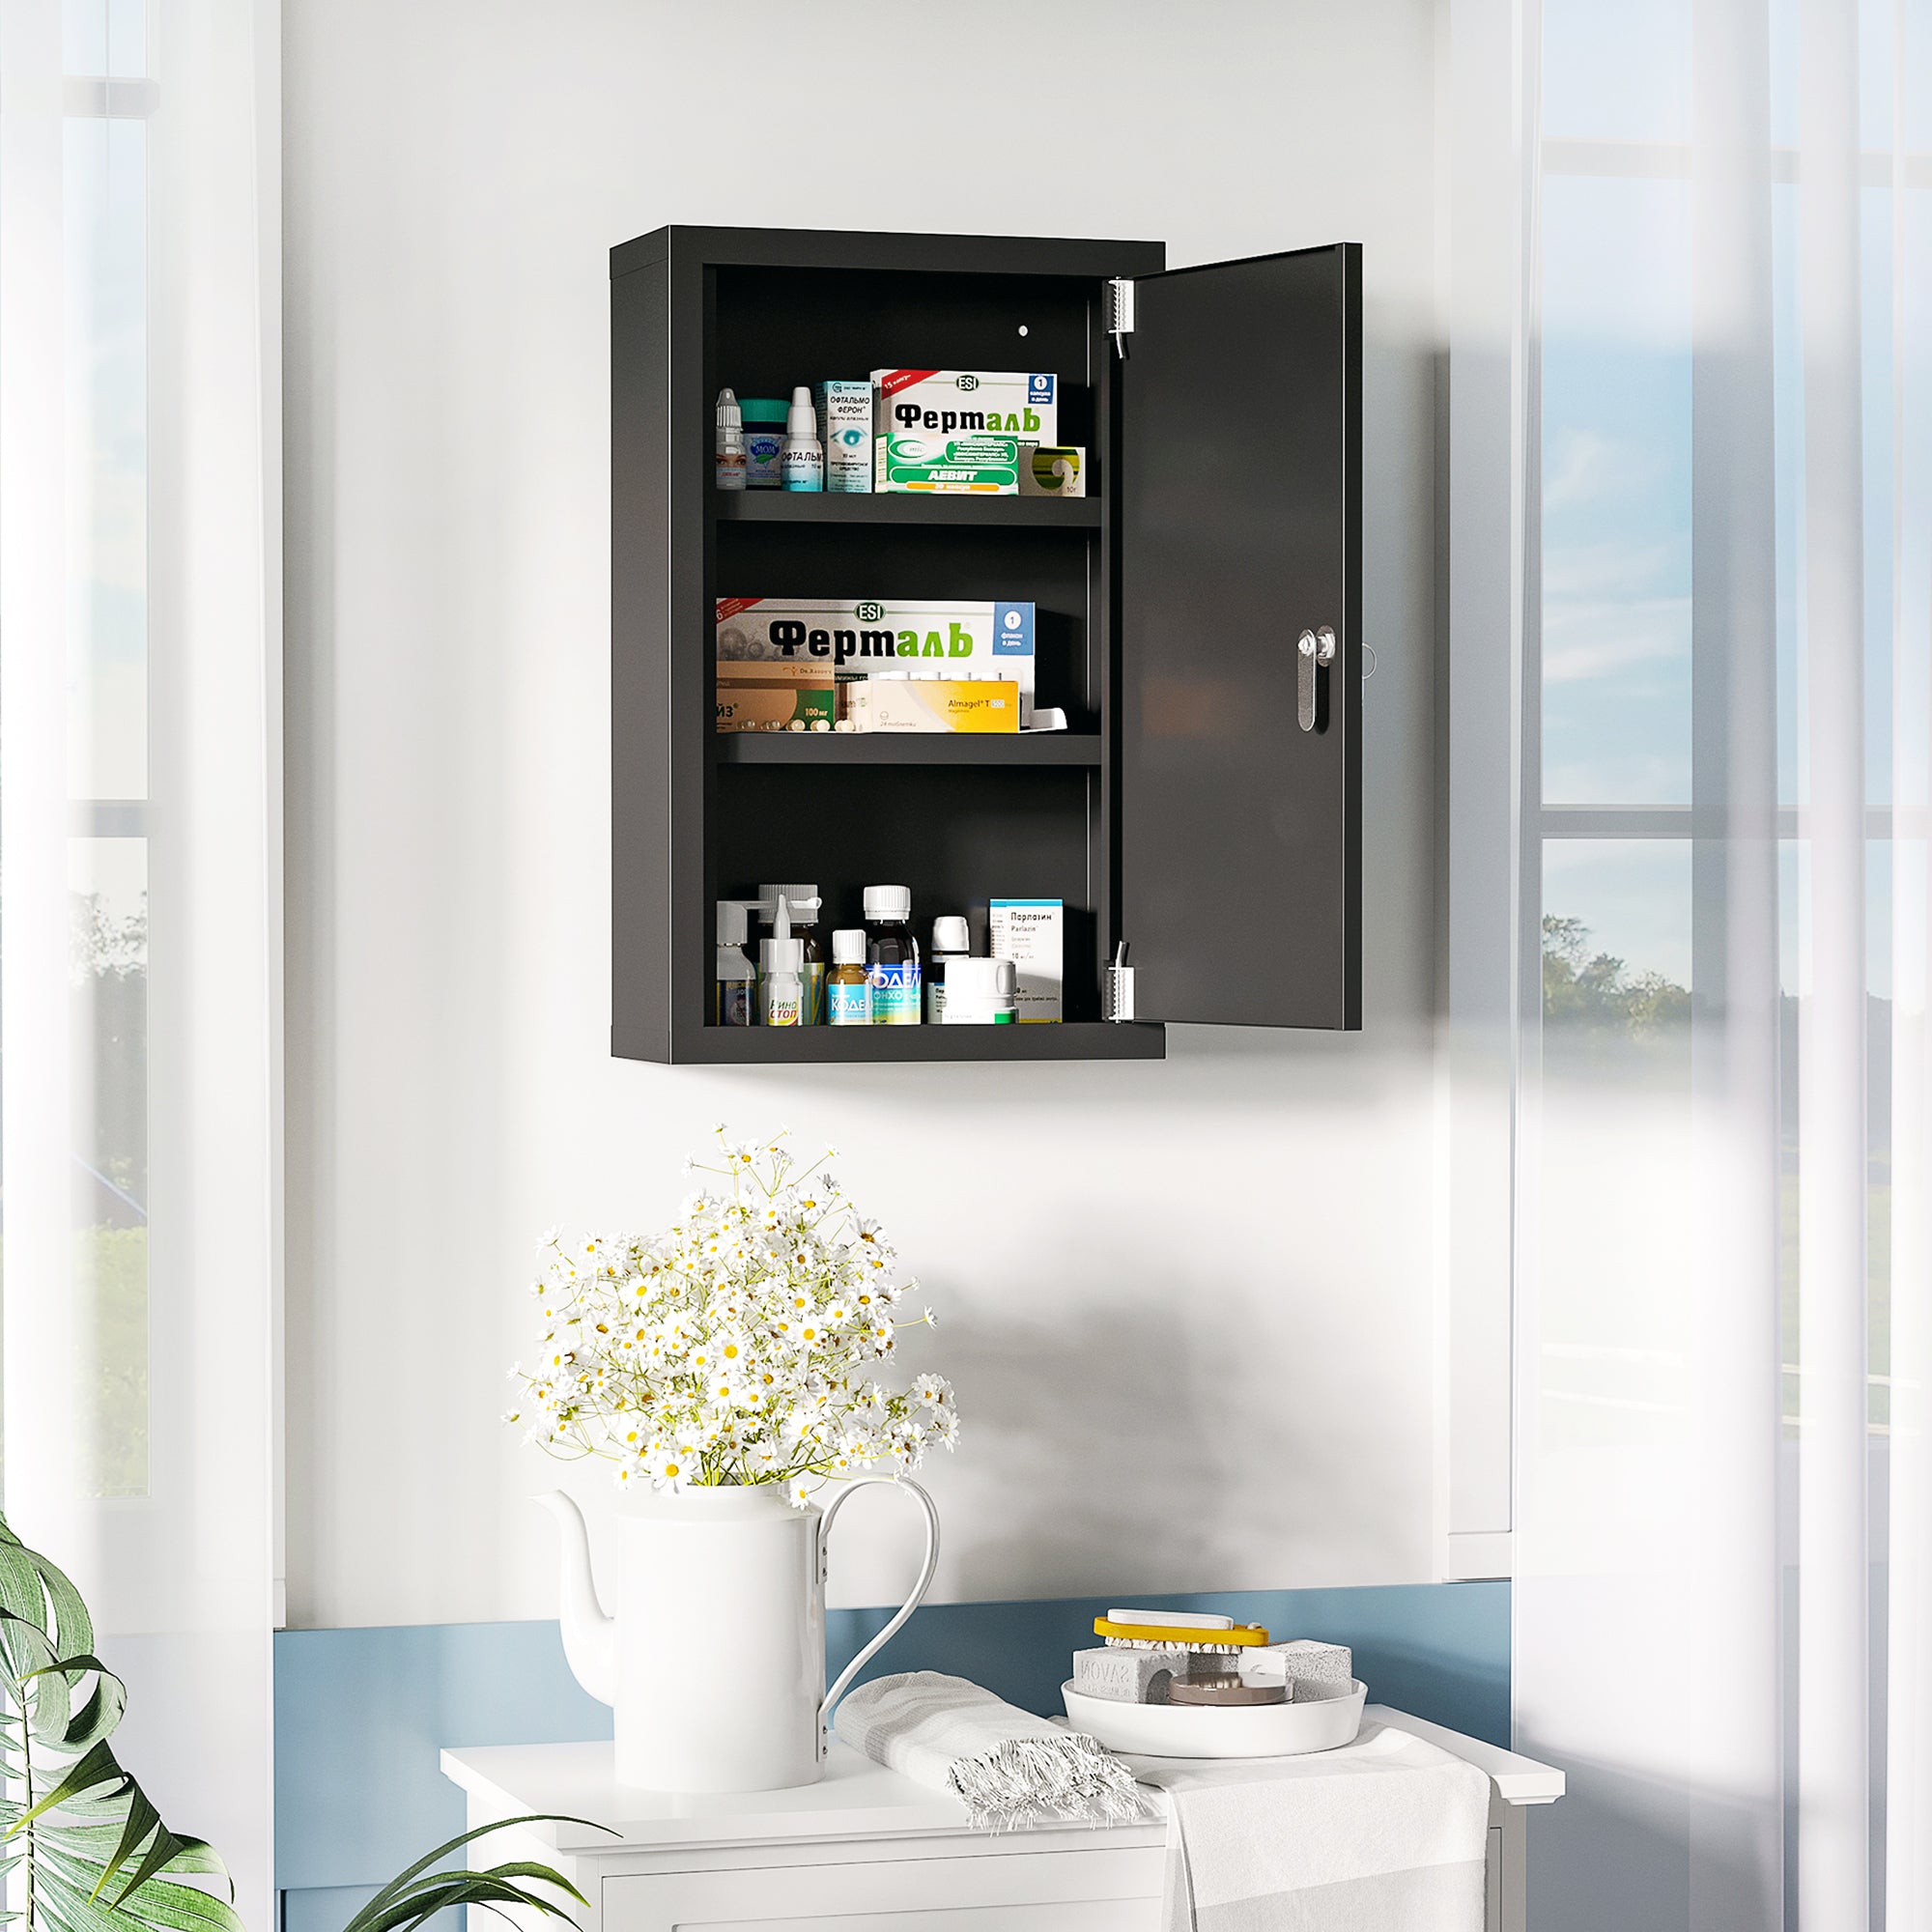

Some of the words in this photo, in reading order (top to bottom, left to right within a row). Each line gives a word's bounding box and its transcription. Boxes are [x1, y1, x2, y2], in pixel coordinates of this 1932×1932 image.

[958, 376, 977, 390] ESI
[831, 396, 870, 405] ОФТАЛЬМО
[895, 404, 1040, 434] Ферталь
[927, 470, 978, 481] АЕВИТ
[859, 605, 881, 620] ESI
[769, 620, 974, 666] Ферталь
[948, 699, 980, 709] Almagel
[805, 708, 818, 717] 100
